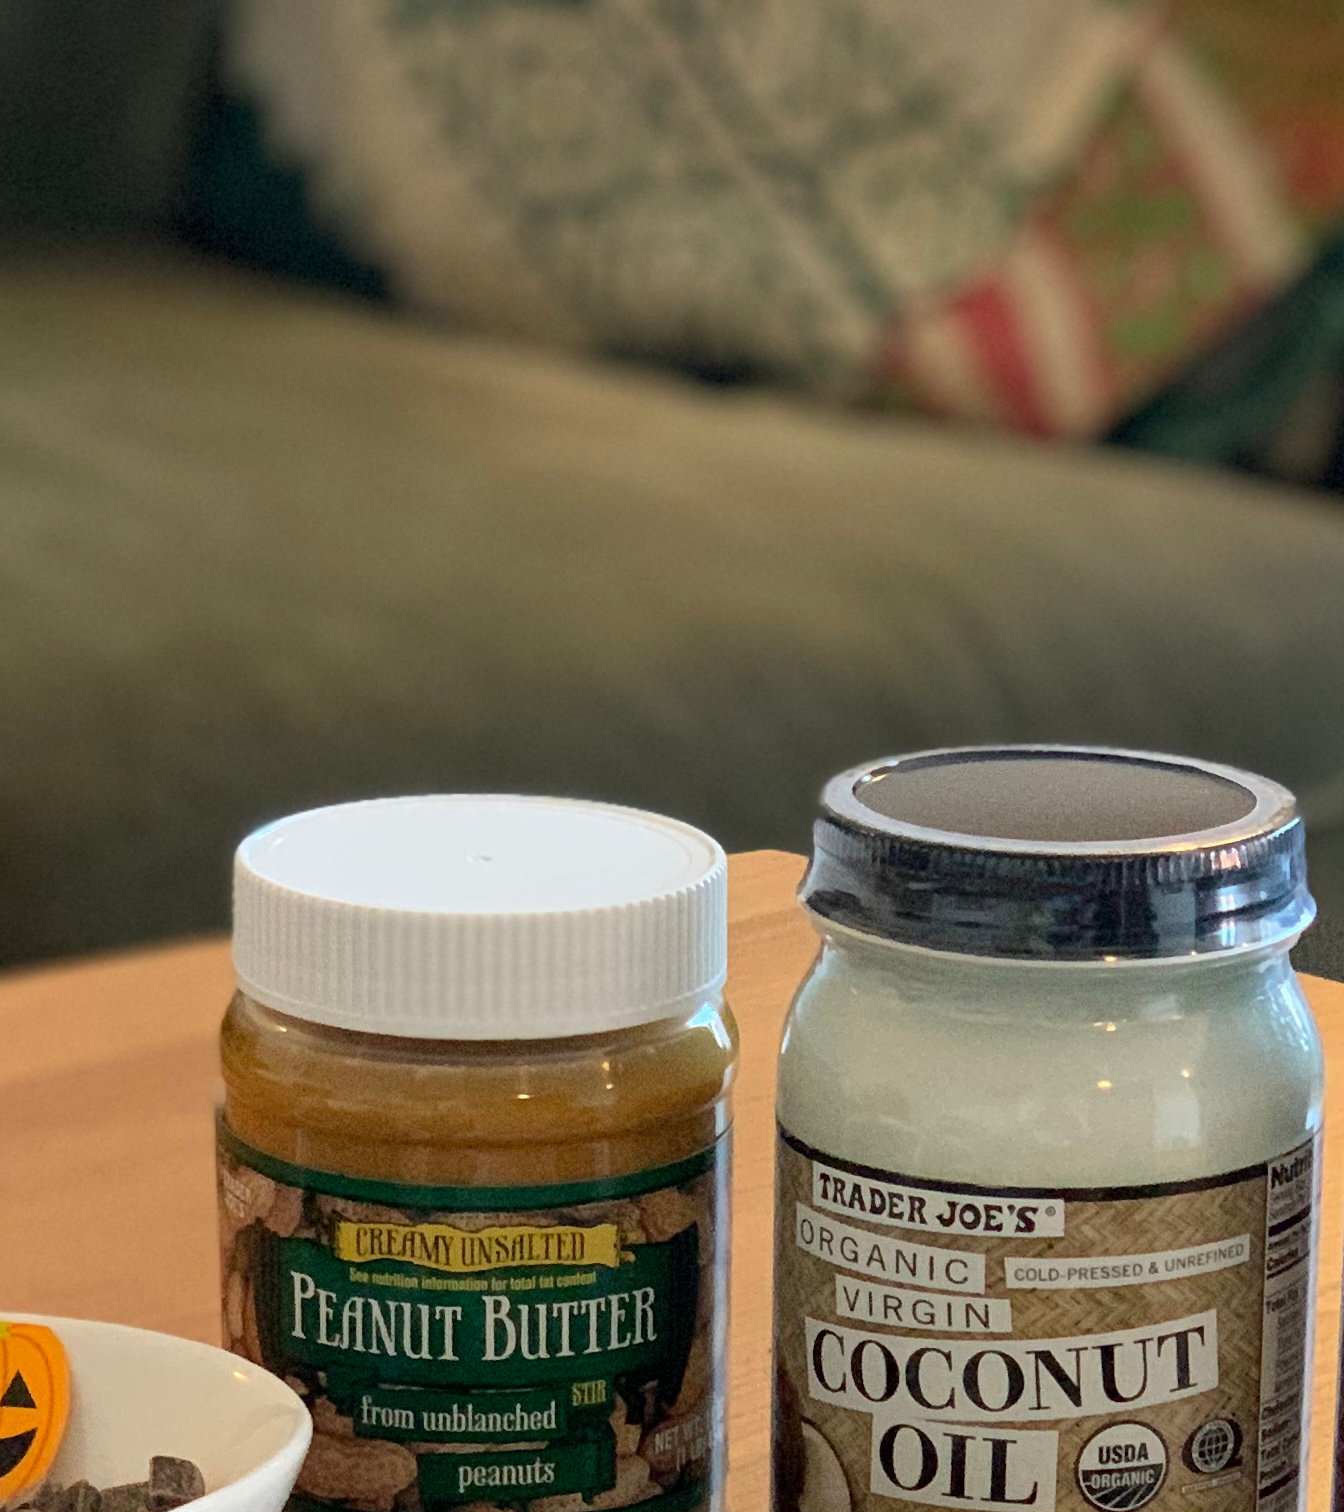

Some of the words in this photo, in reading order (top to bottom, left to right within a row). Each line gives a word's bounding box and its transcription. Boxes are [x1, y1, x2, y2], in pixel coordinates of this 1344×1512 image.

[1271, 1155, 1312, 1189] Nutri
[819, 1173, 927, 1226] TRADER
[937, 1204, 1037, 1234] JOE'S
[357, 1228, 453, 1266] CREAMY
[462, 1231, 584, 1266] UNSALTED
[800, 1217, 969, 1286] ORGANIC
[1014, 1263, 1142, 1283] COLD-PRESSED
[1149, 1261, 1159, 1275] &
[1164, 1243, 1245, 1272] UNREFINED
[372, 1272, 418, 1289] nutrition
[422, 1276, 488, 1290] information
[492, 1277, 506, 1291] for
[511, 1276, 535, 1289] total
[539, 1276, 553, 1288] fat
[290, 1270, 462, 1361] PEANUT
[482, 1286, 656, 1361] BUTTER
[843, 1286, 991, 1330] VIRGIN
[812, 1326, 1205, 1412] COCONUT
[572, 1380, 606, 1406] STIR
[360, 1396, 414, 1431] from
[423, 1401, 556, 1433] unblanched
[879, 1423, 1038, 1505] OIL
[1098, 1443, 1149, 1464] USDA
[459, 1457, 555, 1493] peanuts
[1091, 1469, 1154, 1489] ORGANIC
